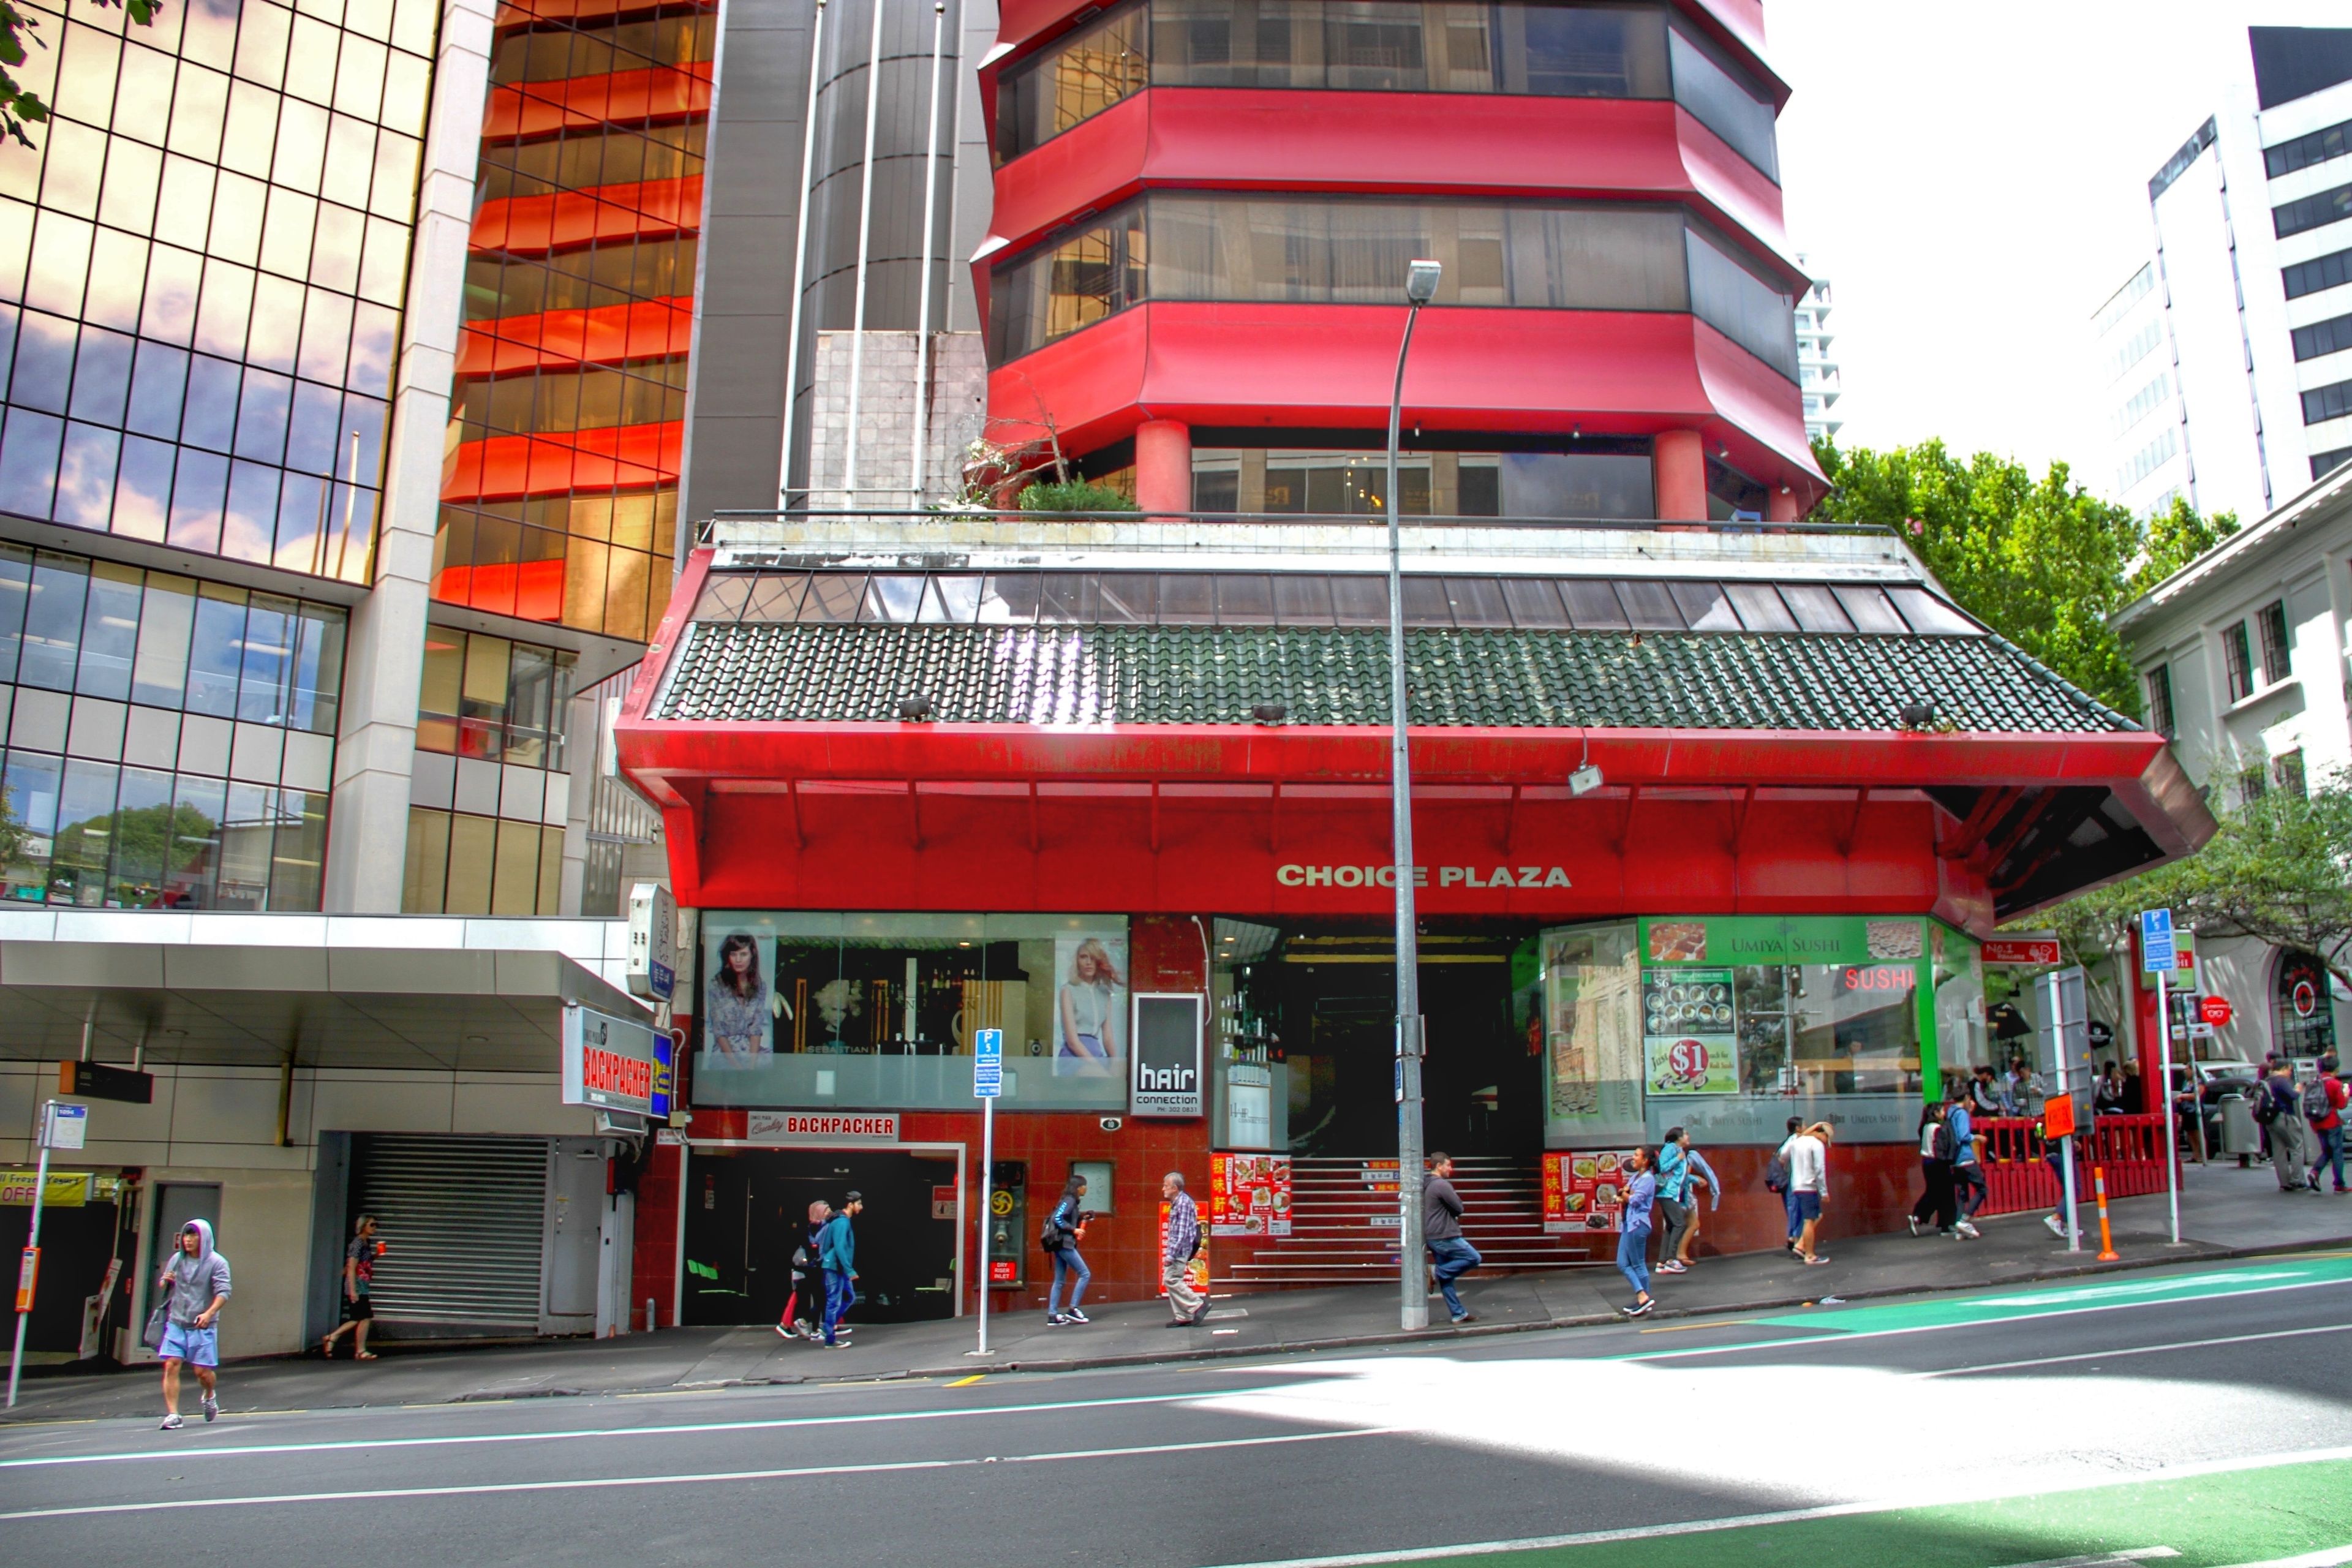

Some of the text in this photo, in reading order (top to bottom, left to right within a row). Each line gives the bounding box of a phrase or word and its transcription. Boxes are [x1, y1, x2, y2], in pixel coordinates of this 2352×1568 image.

[1276, 864, 1572, 888] CHOICE PLAZA
[2151, 911, 2160, 922] P
[1732, 937, 1840, 952] UMIYA SUSHI
[1845, 968, 1915, 990] SUSHI
[984, 1031, 993, 1043] P
[986, 1043, 991, 1052] 5
[1651, 1053, 1668, 1071] Just
[1673, 1042, 1705, 1074] $1
[583, 1045, 651, 1099] BACKPACKER
[1140, 1063, 1194, 1090] hair
[1136, 1095, 1197, 1104] connection
[788, 1116, 894, 1134] BACKPACKER
[1880, 1114, 1904, 1123] SUSHI
[10, 1174, 38, 1183] Froze
[2, 1186, 36, 1202] OFF
